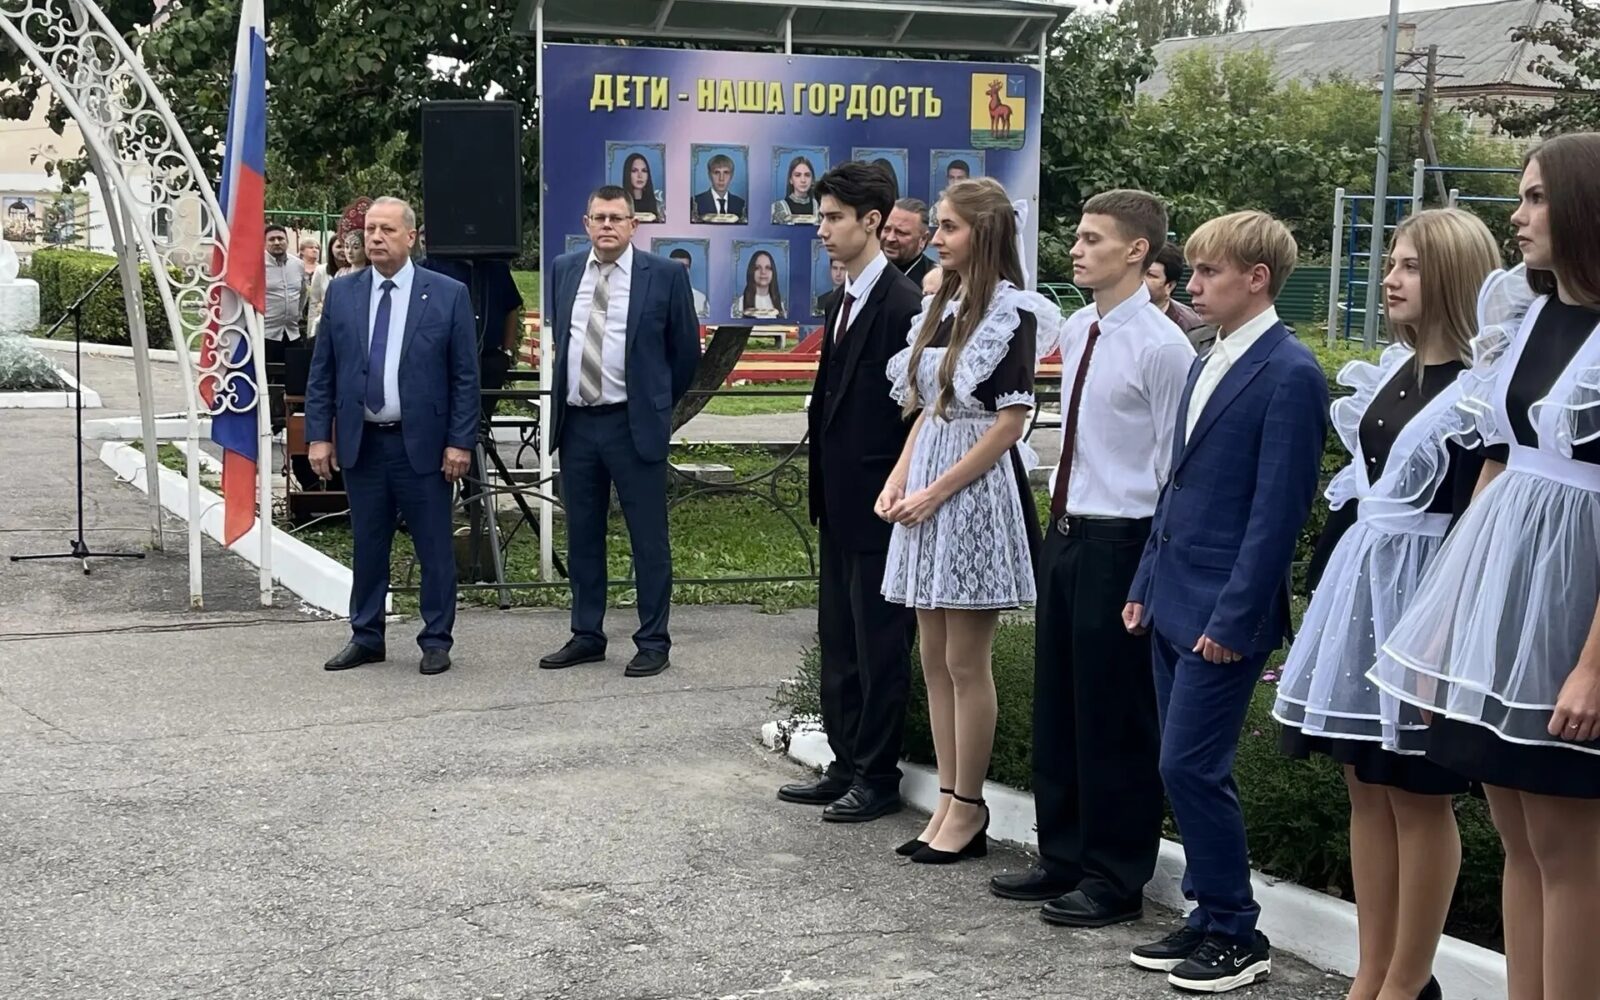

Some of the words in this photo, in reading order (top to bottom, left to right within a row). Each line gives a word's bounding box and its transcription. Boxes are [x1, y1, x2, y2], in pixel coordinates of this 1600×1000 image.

[589, 73, 669, 112] ДЕТИ
[697, 78, 786, 114] НАША
[793, 82, 942, 121] ГОРДОСТЬ
